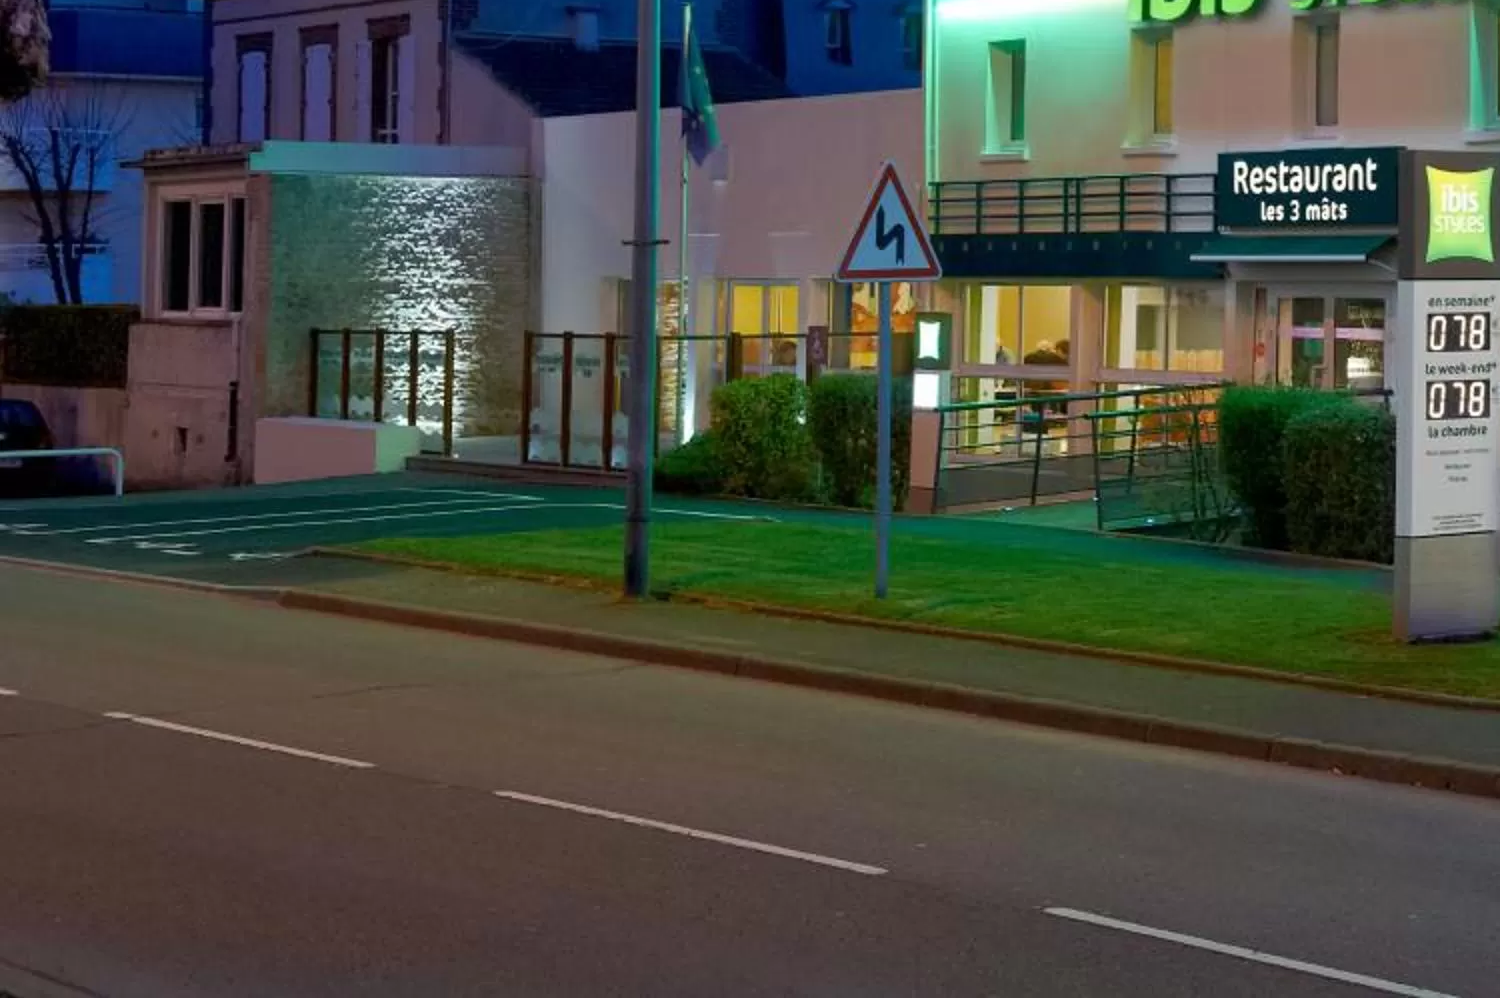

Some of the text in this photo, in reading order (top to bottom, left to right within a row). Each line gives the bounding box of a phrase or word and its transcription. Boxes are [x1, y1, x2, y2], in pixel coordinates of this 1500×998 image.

[1233, 157, 1377, 195] Restaurant
[1261, 198, 1347, 221] les 3 mâts
[1441, 184, 1479, 213] ibis
[1429, 314, 1487, 351] 078
[1428, 381, 1486, 418] 078
[1441, 423, 1488, 437] chambre
